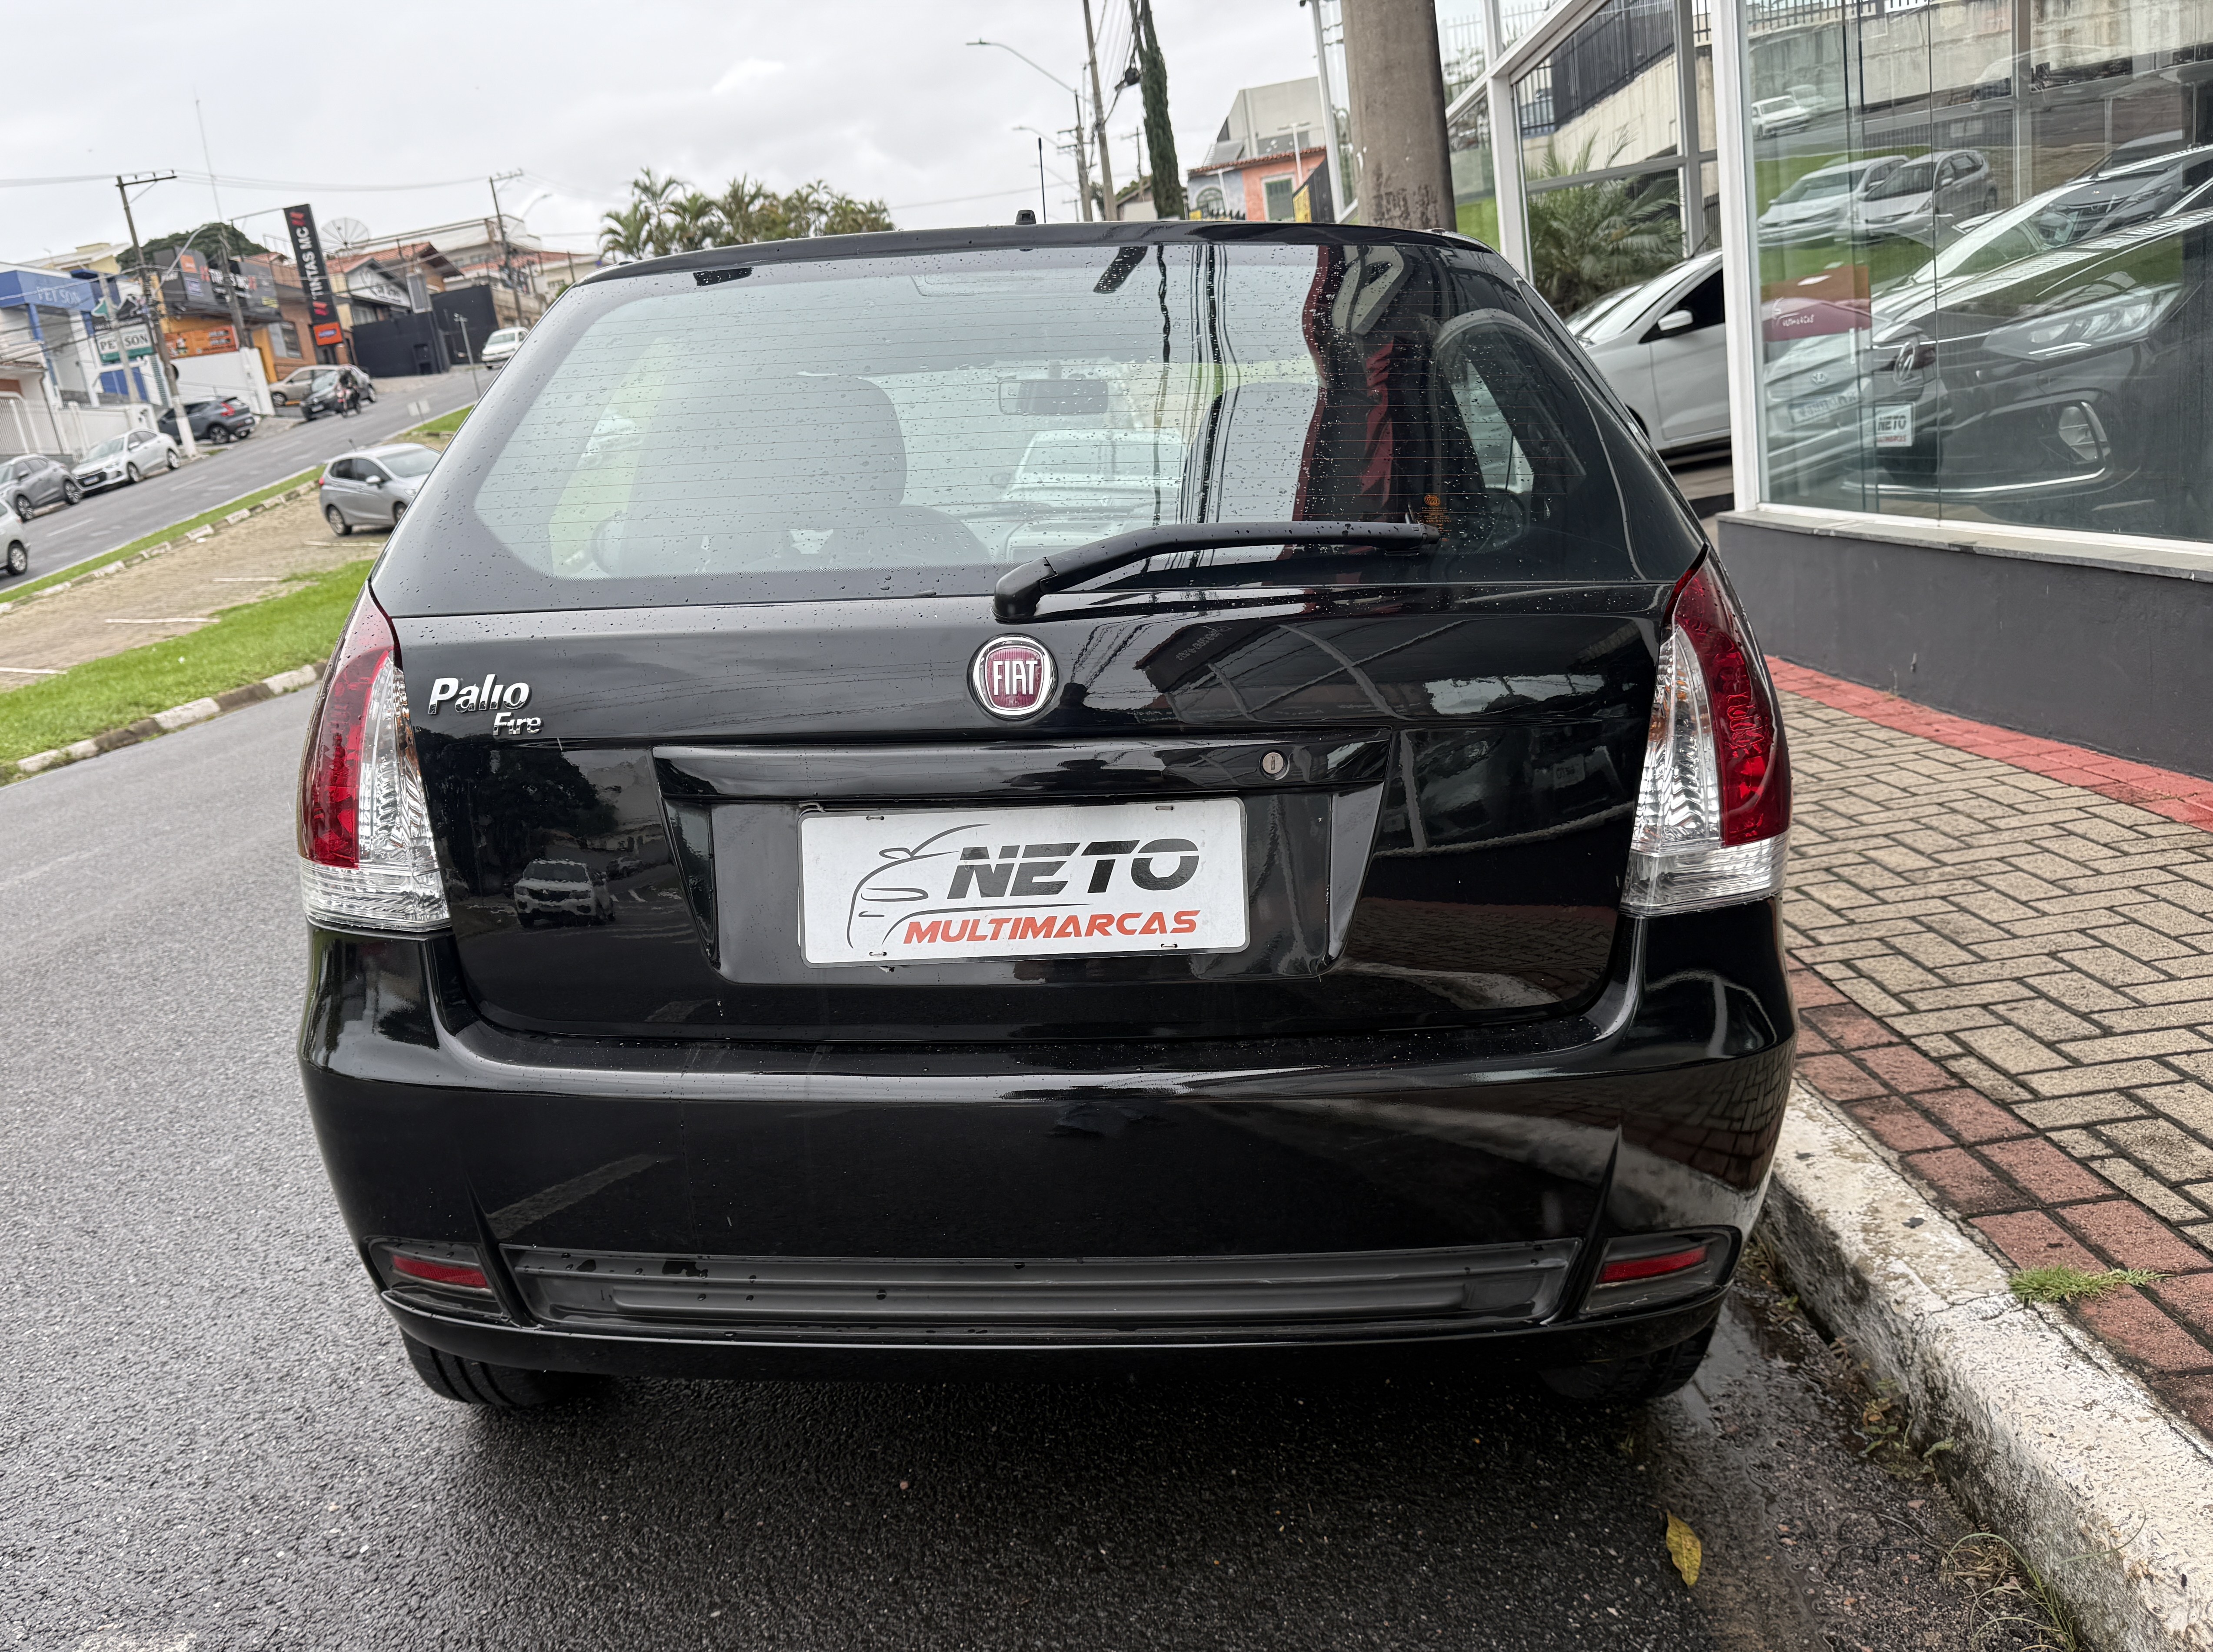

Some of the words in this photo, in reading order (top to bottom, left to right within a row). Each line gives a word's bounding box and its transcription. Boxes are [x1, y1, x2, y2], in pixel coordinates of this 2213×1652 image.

[296, 226, 312, 250] MC
[302, 251, 325, 300] TINTAS
[100, 338, 117, 351] PE
[428, 674, 531, 715] Palio
[993, 660, 1038, 695] FIAT
[493, 712, 543, 736] Fire
[947, 838, 1200, 899] NETO
[903, 910, 1201, 944] MULTIMARCAS
